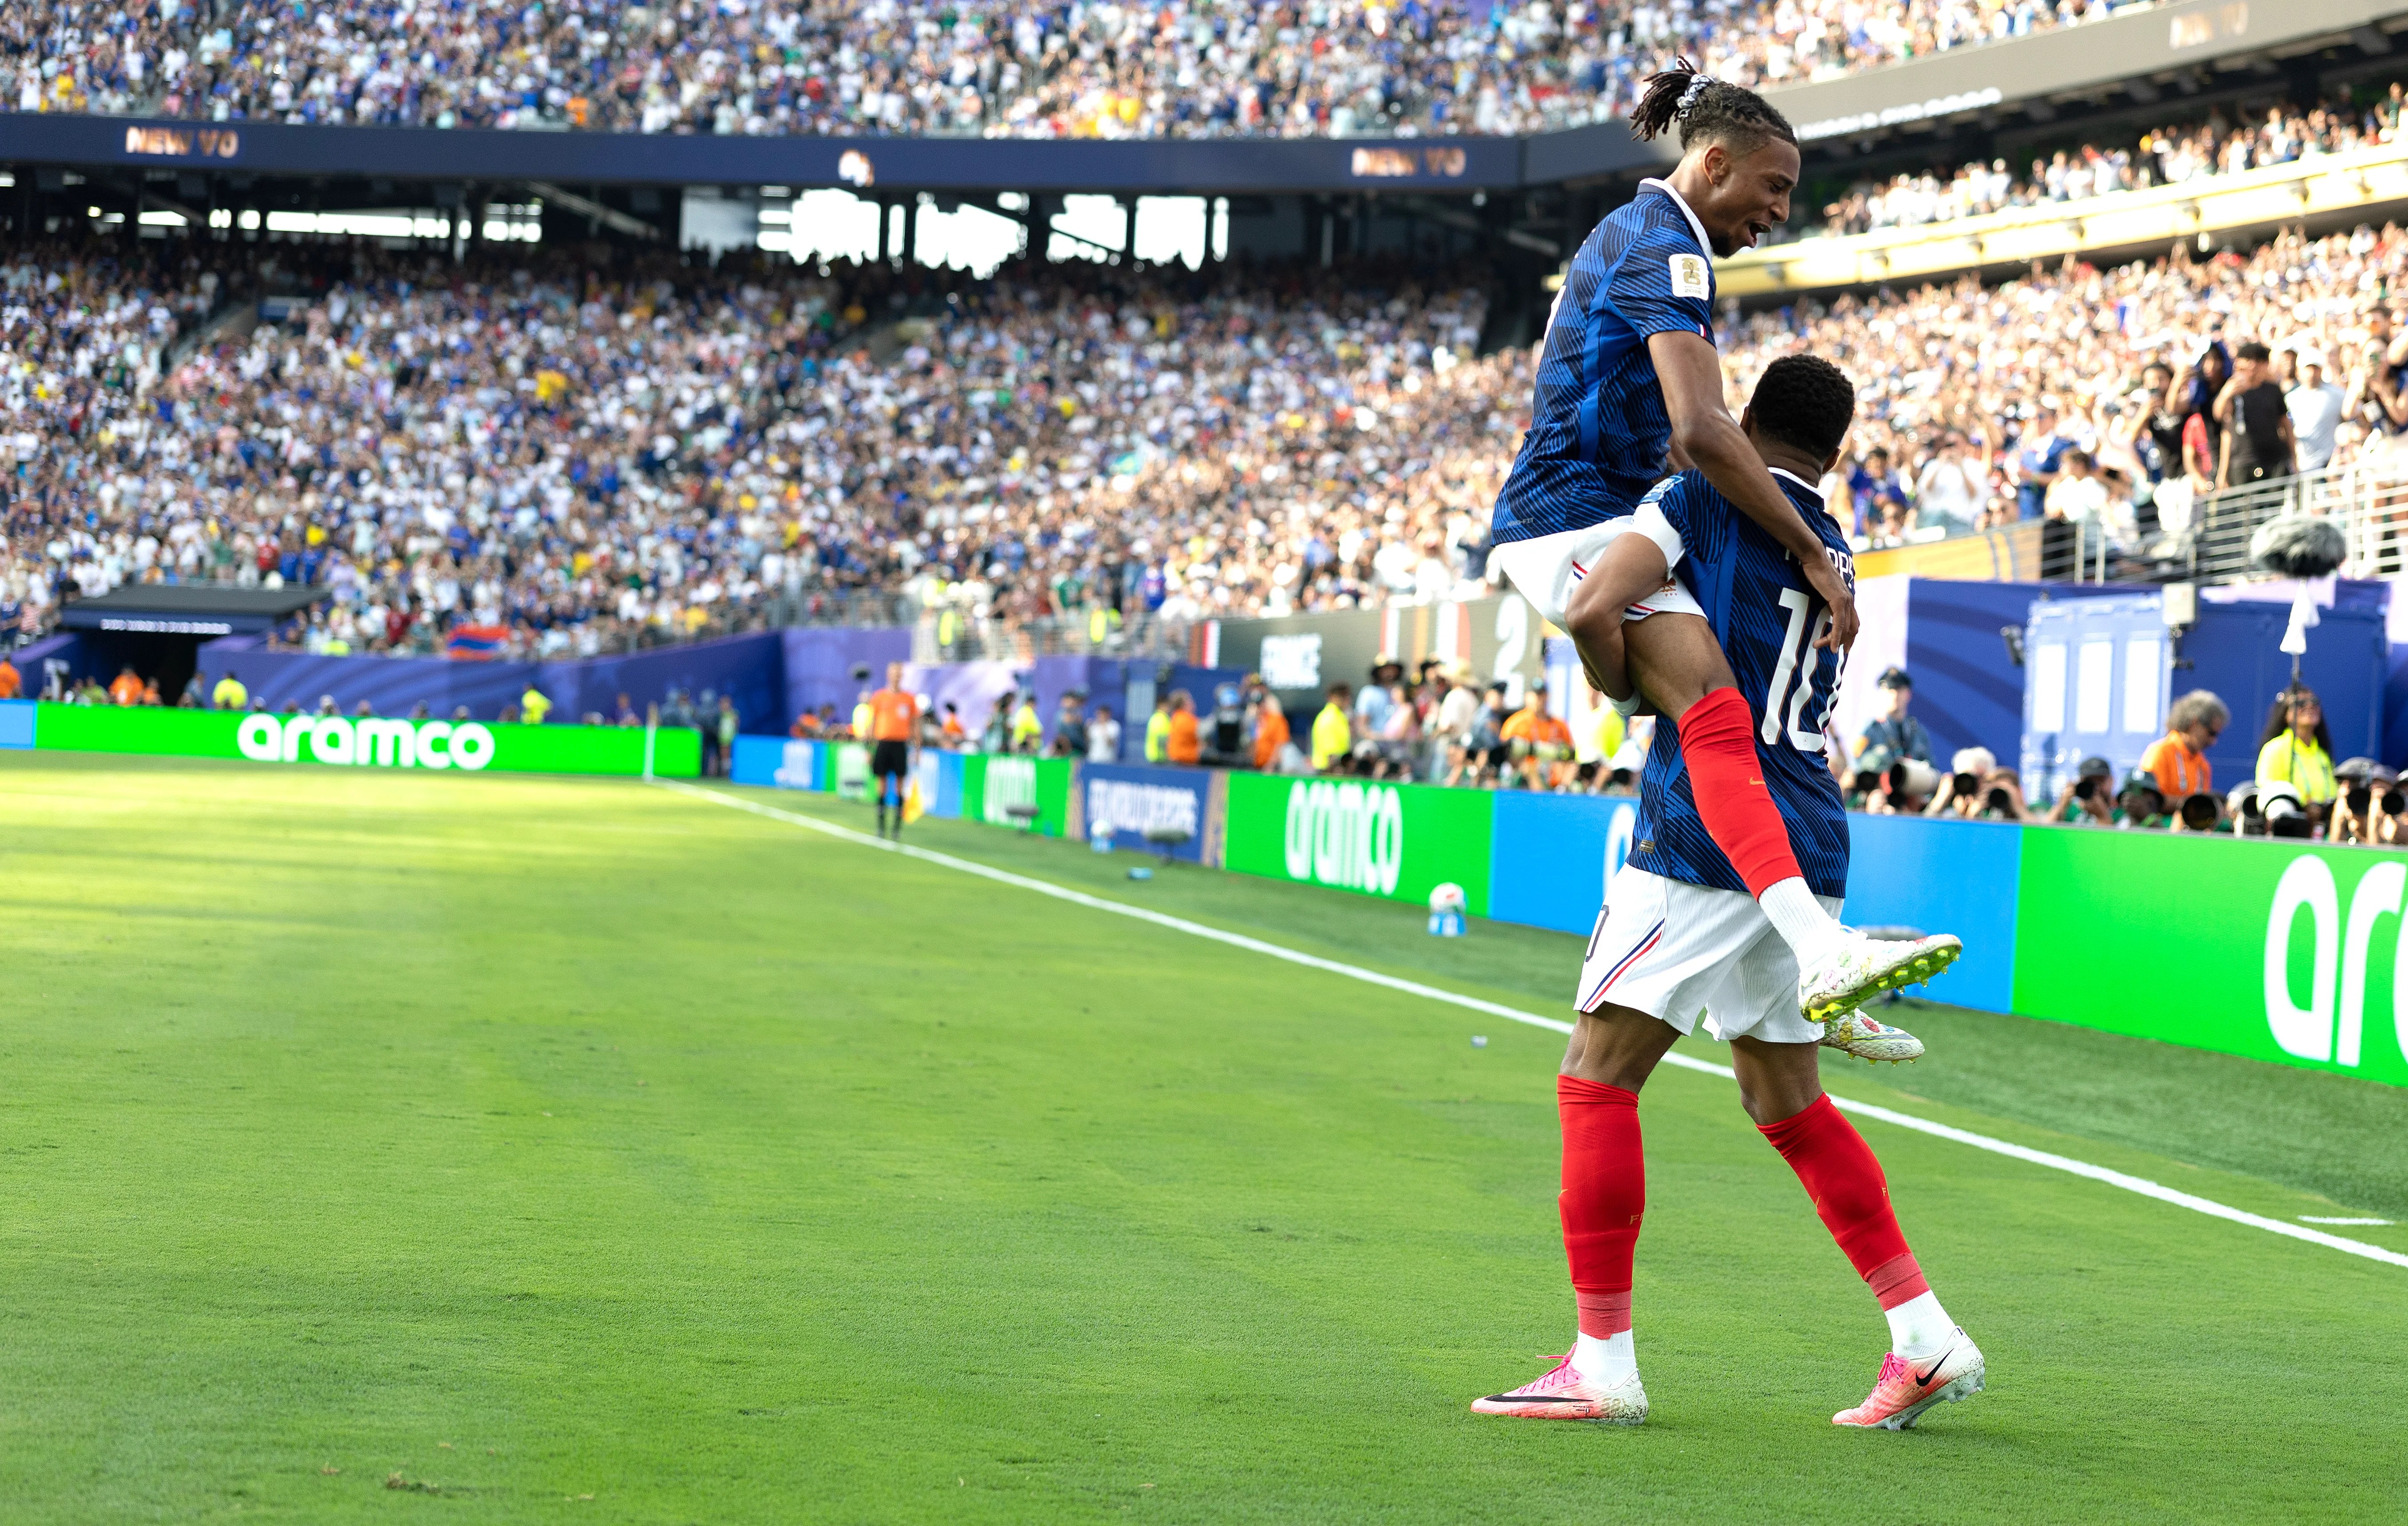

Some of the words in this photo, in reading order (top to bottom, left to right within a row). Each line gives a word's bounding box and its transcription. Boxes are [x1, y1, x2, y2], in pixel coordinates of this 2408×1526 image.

[1761, 587, 1844, 752] 10
[237, 713, 496, 770] aramco
[1285, 780, 1403, 895] aramco
[2263, 854, 2408, 1068] ar
